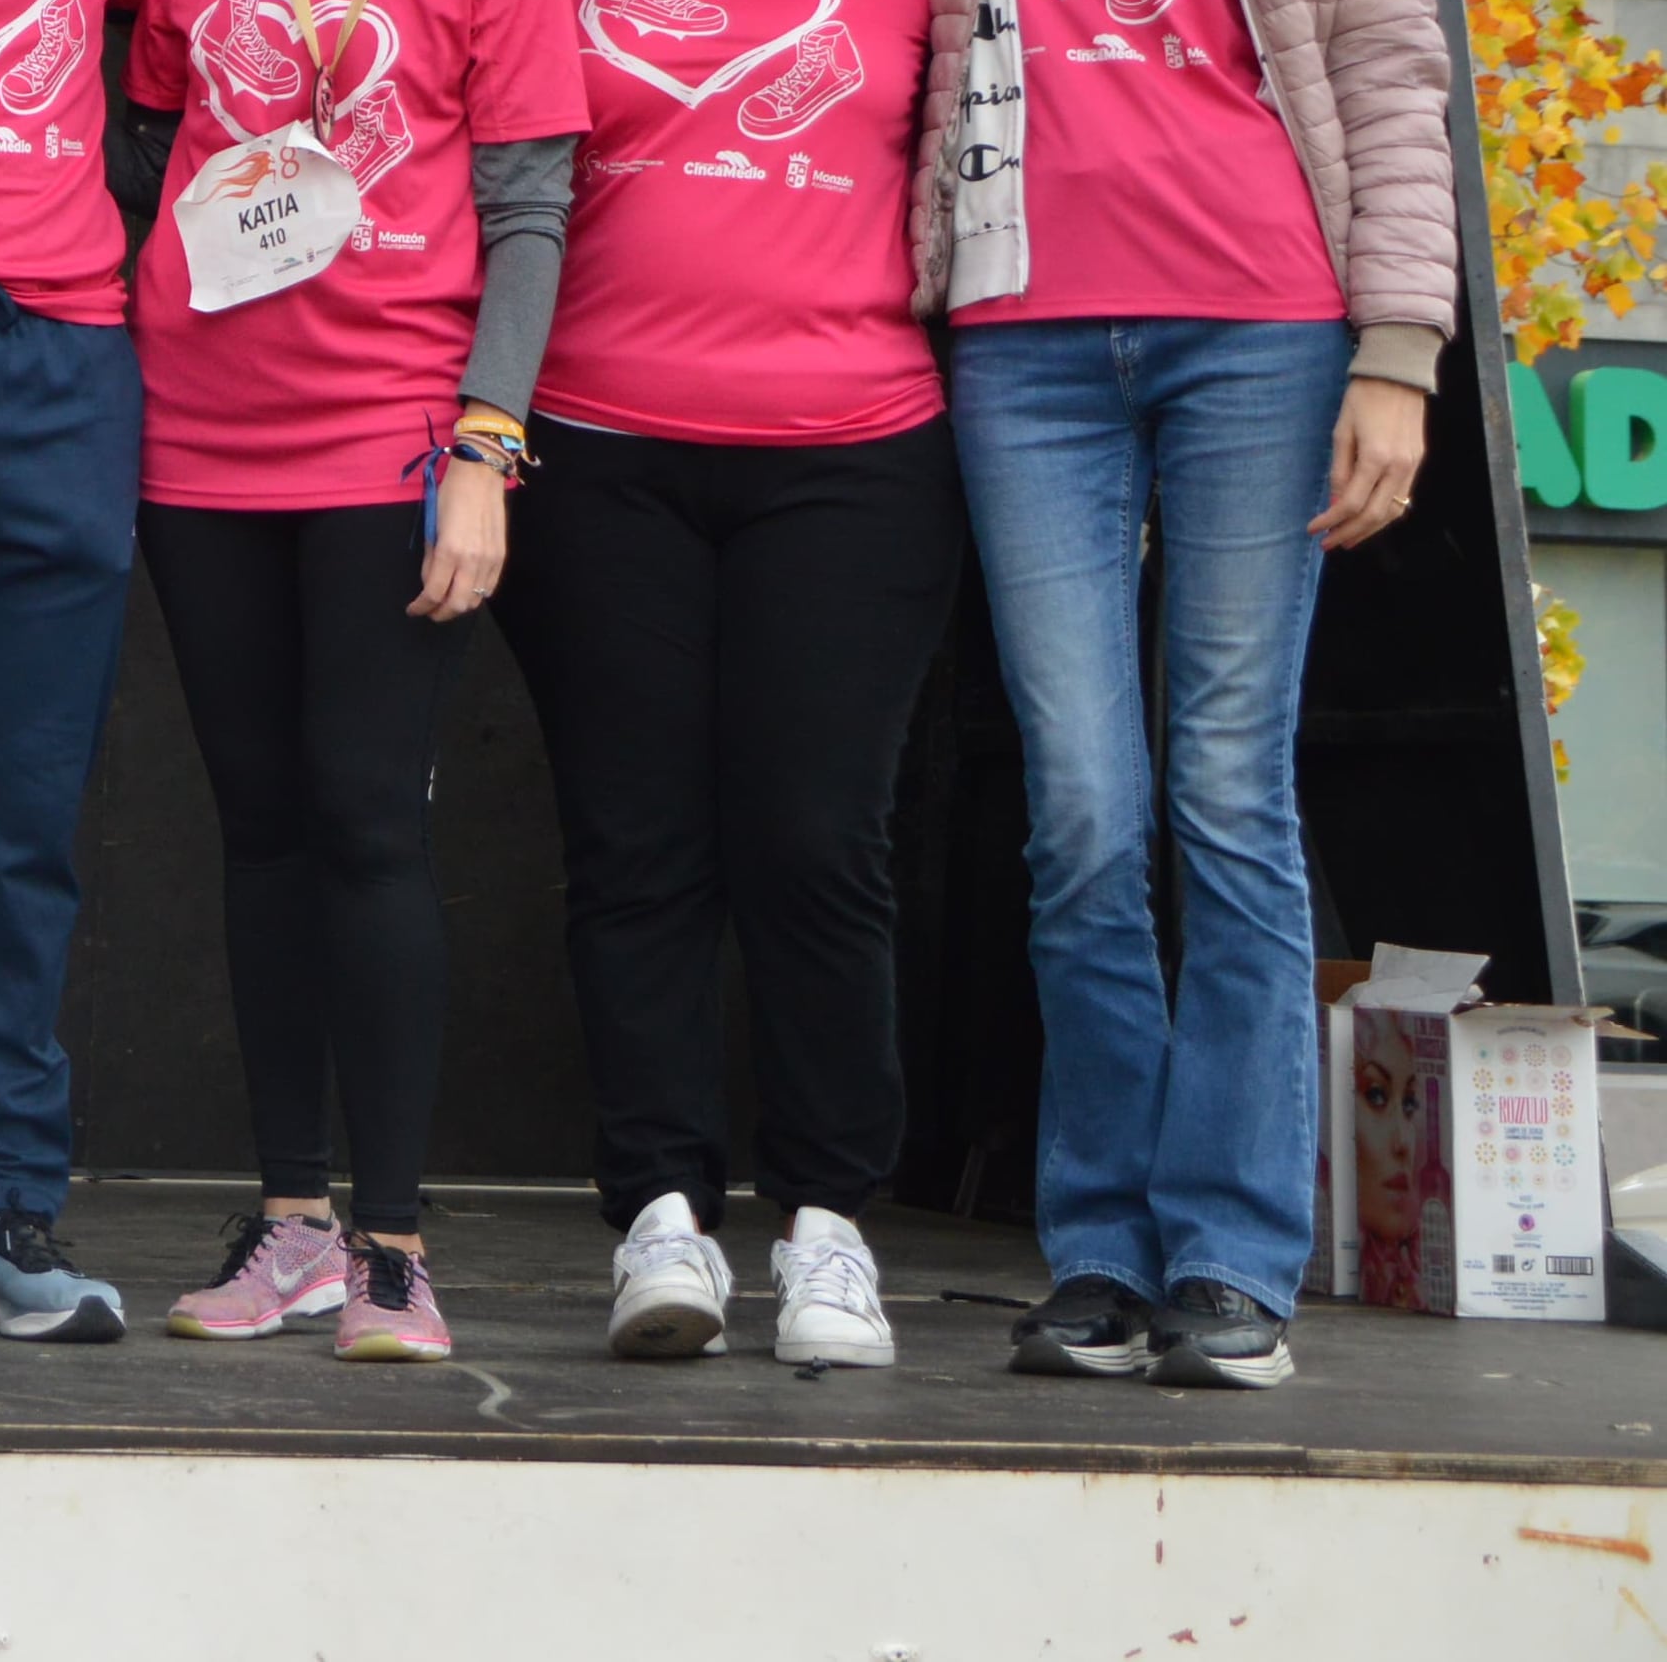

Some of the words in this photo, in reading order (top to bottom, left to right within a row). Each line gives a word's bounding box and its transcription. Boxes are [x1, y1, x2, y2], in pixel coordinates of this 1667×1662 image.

[279, 146, 300, 180] 8
[683, 161, 766, 180] CincaMedio
[812, 169, 854, 187] Monzón
[237, 193, 299, 234] KATIA
[259, 227, 287, 251] 410
[378, 230, 426, 244] Monzón
